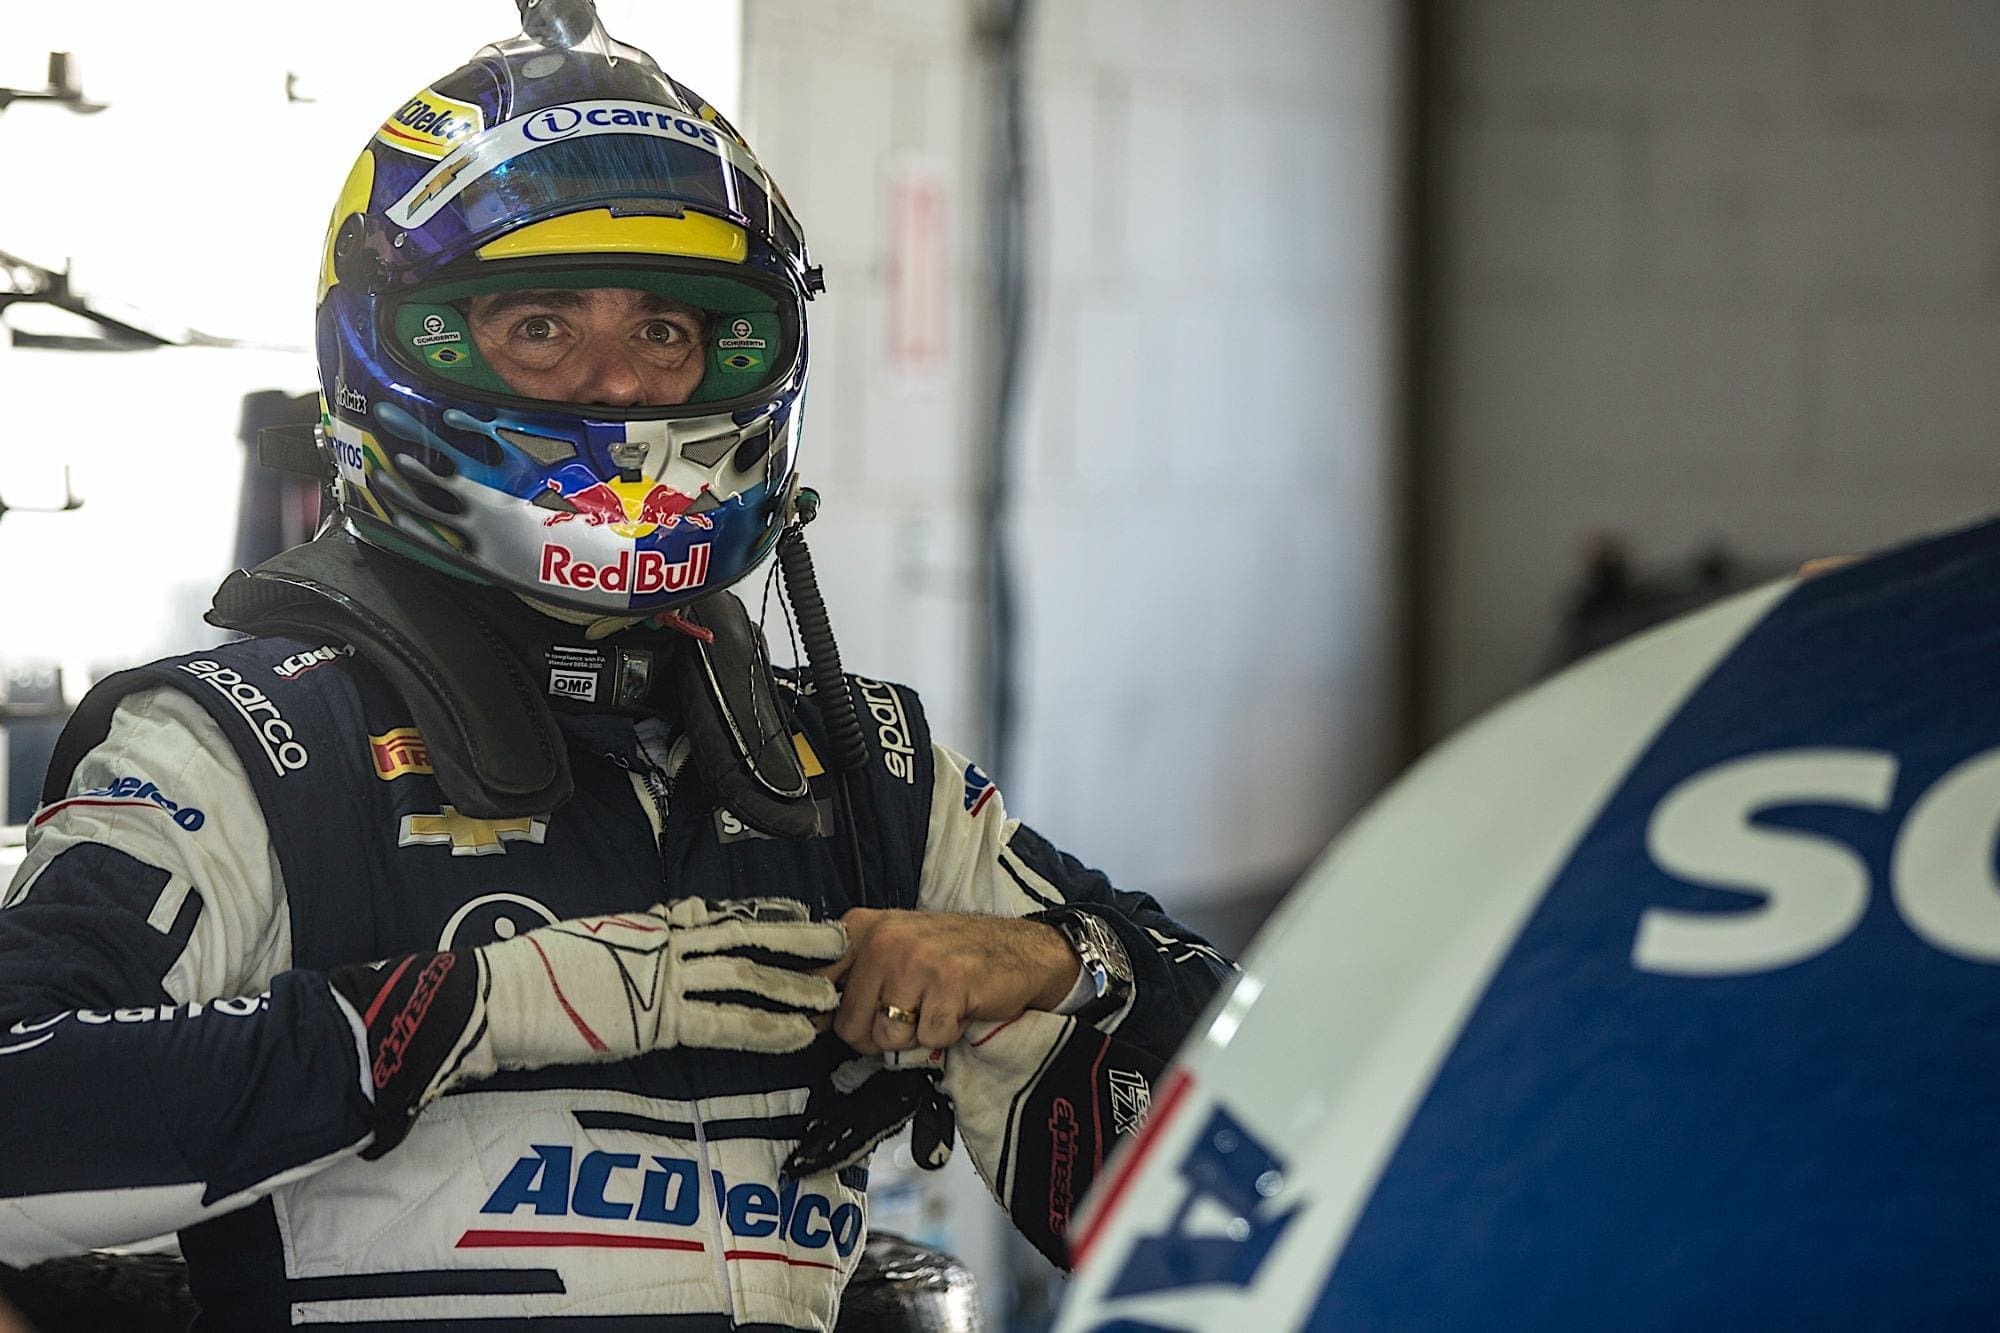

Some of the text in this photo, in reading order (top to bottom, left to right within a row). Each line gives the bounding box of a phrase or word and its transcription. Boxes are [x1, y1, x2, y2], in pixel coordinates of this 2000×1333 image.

[539, 542, 711, 594] Red Bull
[184, 659, 308, 772] sparco
[554, 678, 593, 693] OMP
[479, 1144, 863, 1258] ACDelco
